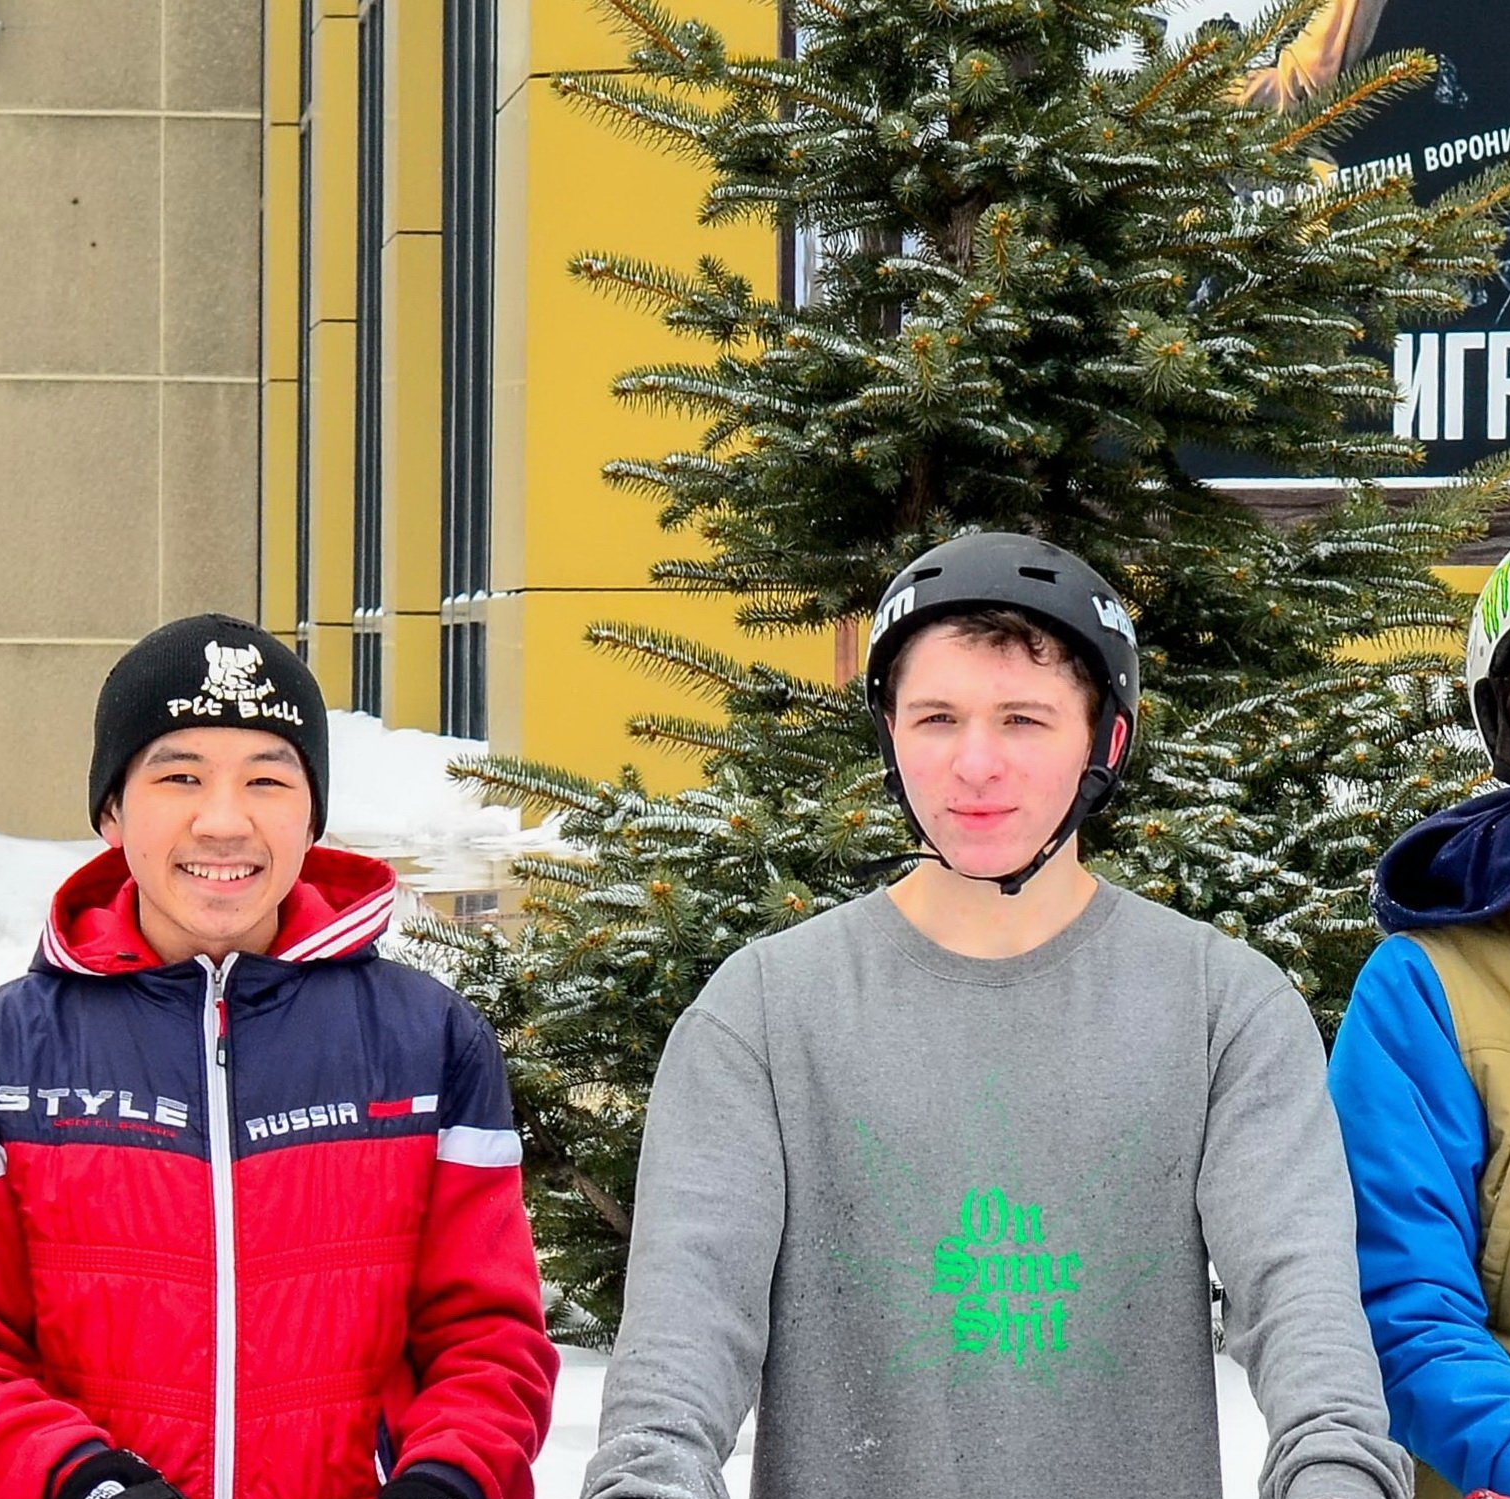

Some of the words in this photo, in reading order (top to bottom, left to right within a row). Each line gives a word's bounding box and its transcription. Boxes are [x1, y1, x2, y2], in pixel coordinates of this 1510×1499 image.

[245, 1101, 359, 1142] RUSSIA
[960, 1185, 1047, 1247] On
[928, 1234, 1084, 1295] Some
